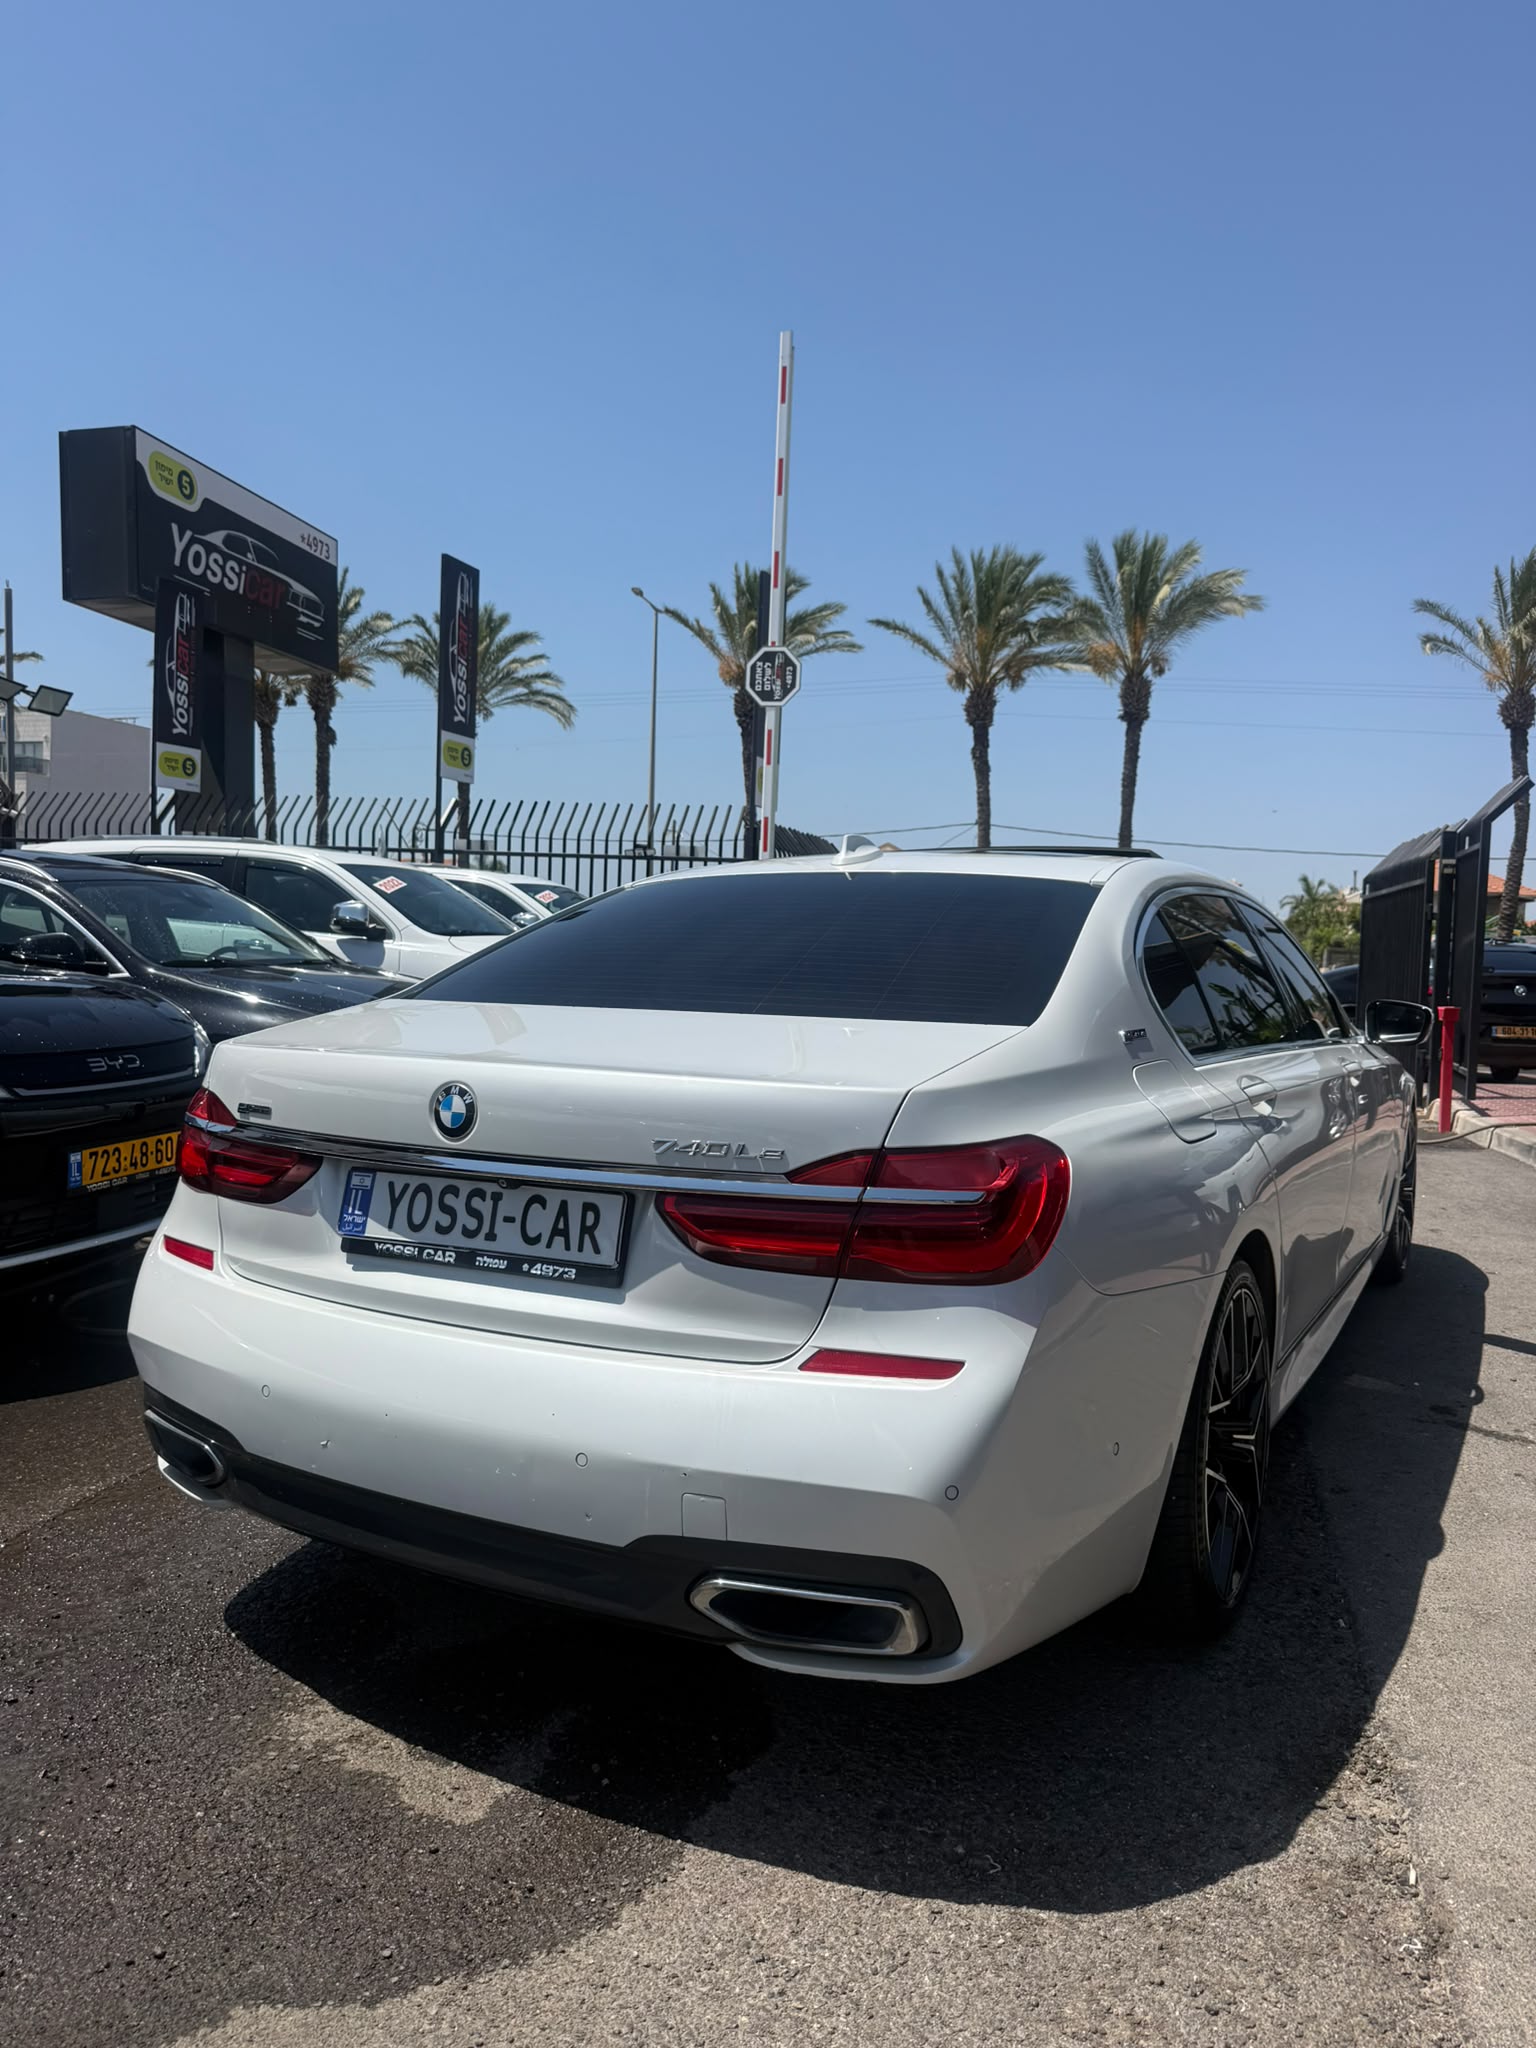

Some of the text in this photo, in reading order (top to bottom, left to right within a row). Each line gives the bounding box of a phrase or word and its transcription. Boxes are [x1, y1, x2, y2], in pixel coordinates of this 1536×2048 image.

[181, 474, 191, 496] 5
[86, 1054, 141, 1072] BYD
[438, 1085, 473, 1104] BMW
[348, 1189, 362, 1215] IL
[343, 1214, 366, 1224] ישראל
[387, 1180, 601, 1255] YOSSI-CAR
[374, 1242, 418, 1259] YOSSI
[422, 1248, 456, 1265] CAR
[475, 1255, 508, 1269] עפולה
